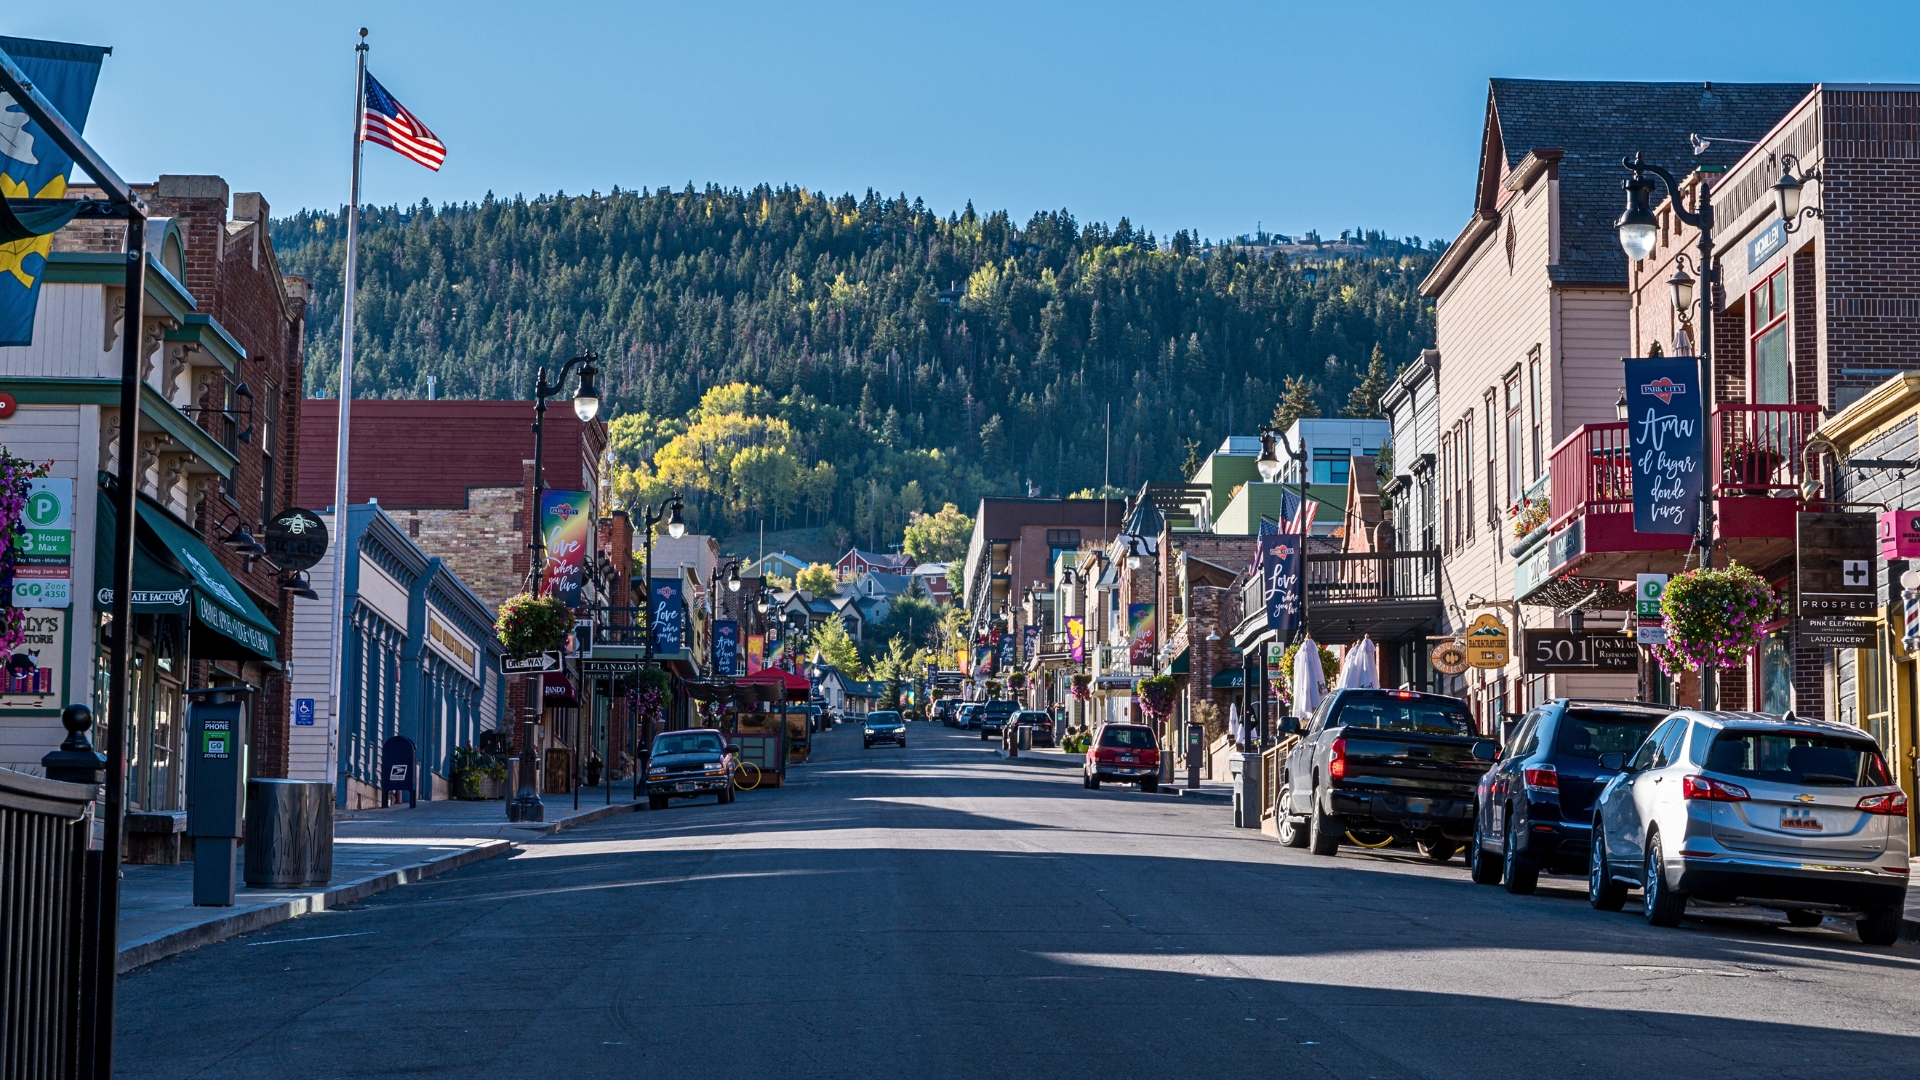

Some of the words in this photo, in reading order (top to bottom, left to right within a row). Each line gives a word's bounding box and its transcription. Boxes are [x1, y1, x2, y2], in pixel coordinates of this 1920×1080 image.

[1637, 407, 1695, 451] Ama
[1639, 450, 1654, 475] el
[1657, 451, 1696, 479] lugar
[1651, 475, 1686, 502] donde
[36, 499, 52, 519] P
[1651, 503, 1686, 525] vives
[22, 533, 34, 551] 3
[39, 534, 65, 543] Hours
[39, 543, 57, 552] Max
[540, 525, 581, 572] Love
[554, 559, 580, 575] where
[546, 576, 561, 596] you
[560, 576, 578, 592] live
[1265, 564, 1298, 602] Love
[1649, 584, 1658, 596] P
[1641, 602, 1648, 613] 3
[1802, 600, 1875, 609] PROSPECT
[652, 601, 678, 631] Love
[1129, 622, 1152, 648] Love
[1810, 636, 1866, 644] LANDJUICERY
[1536, 640, 1590, 662] 501
[508, 659, 525, 668] ONE
[528, 658, 544, 667] WAY
